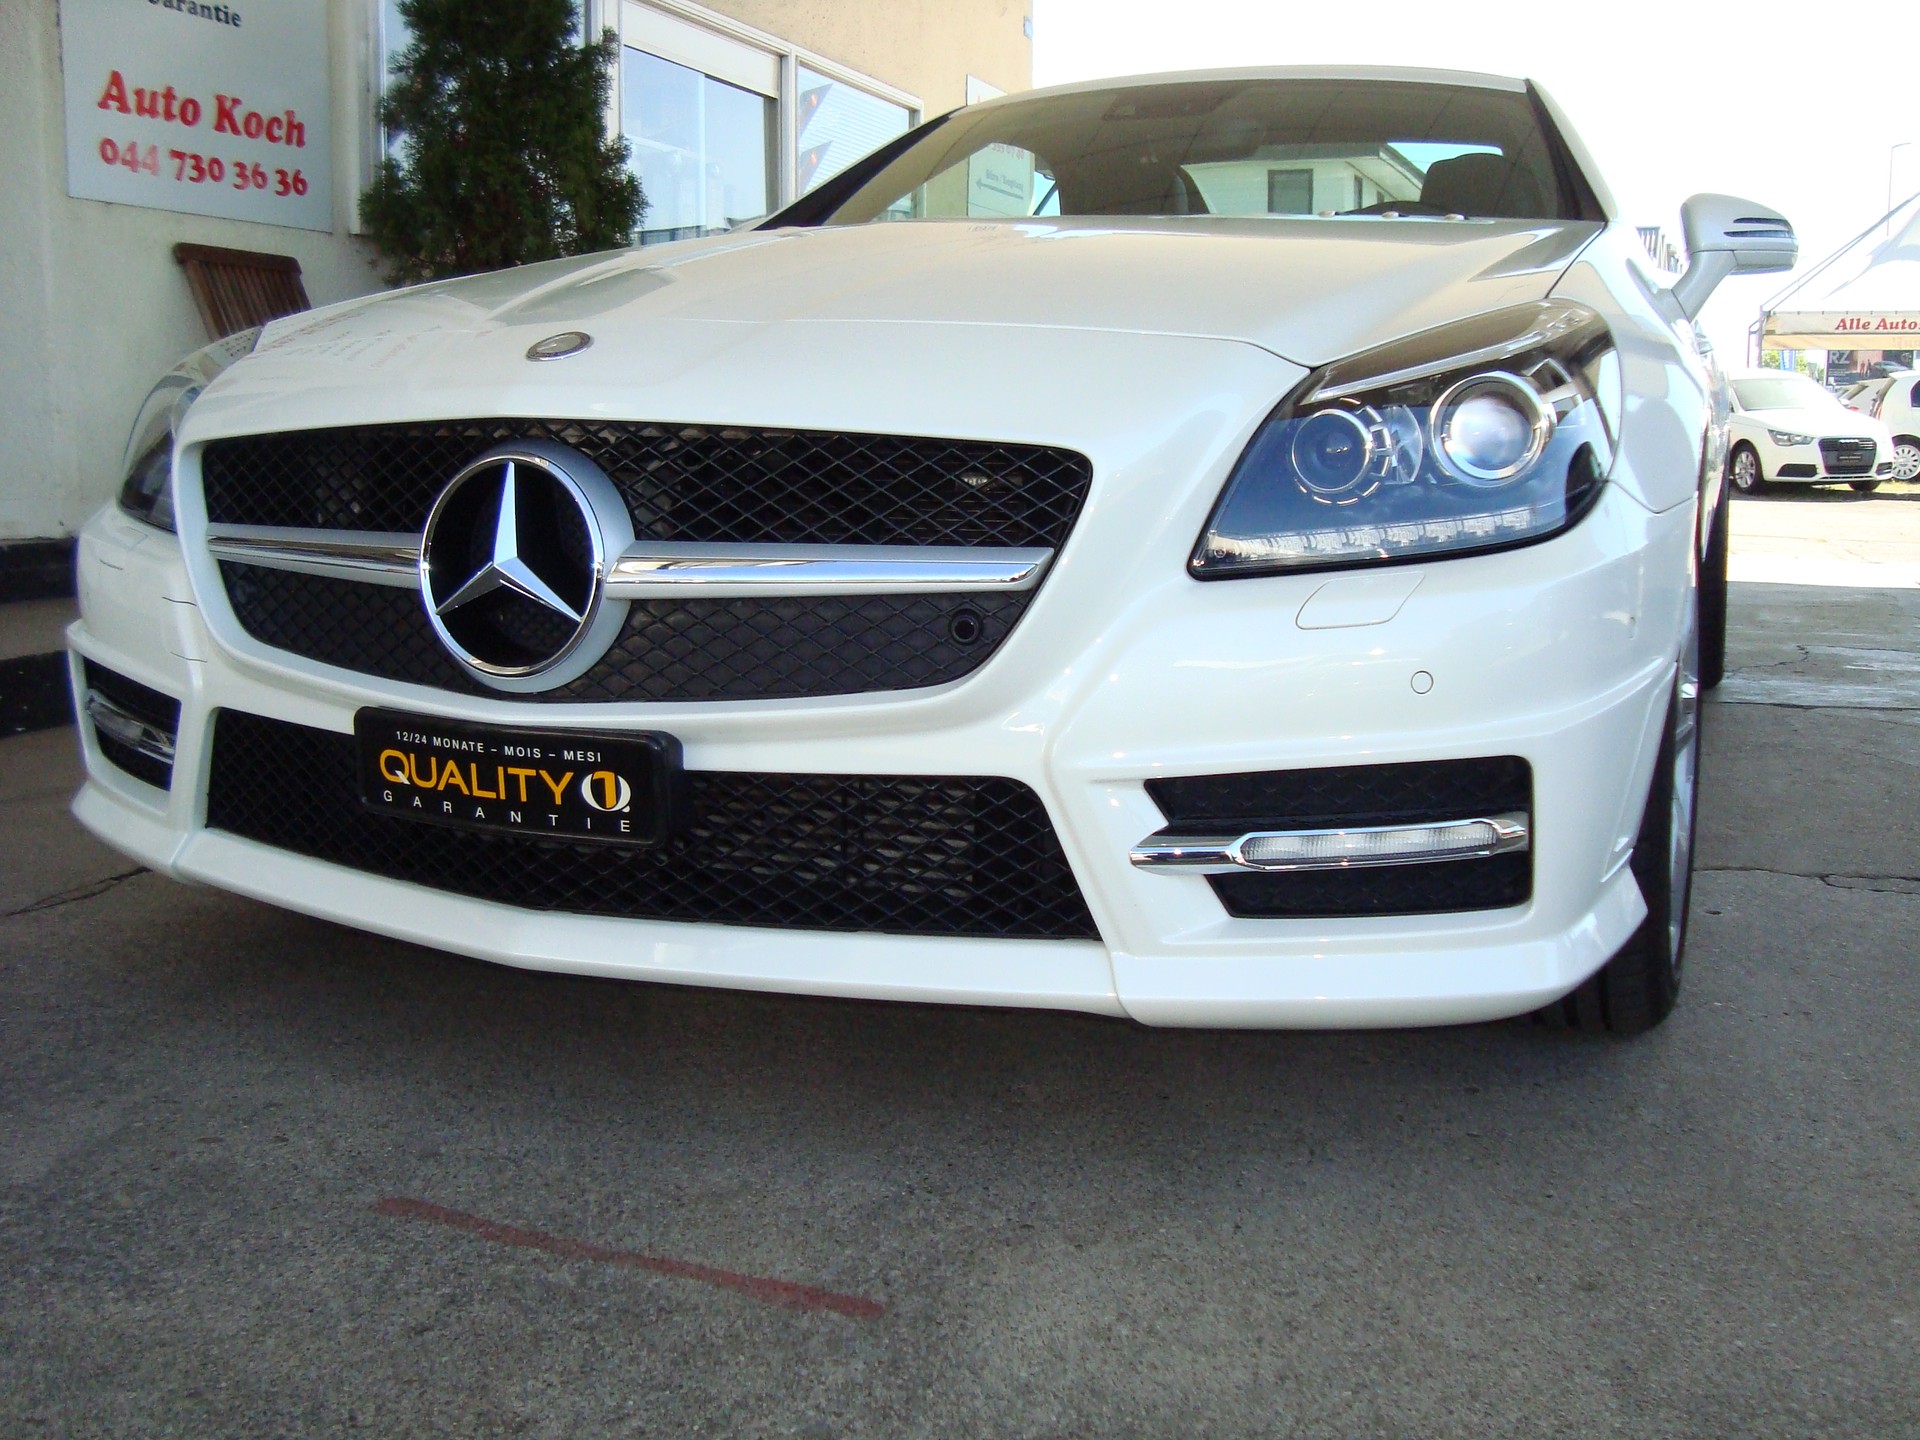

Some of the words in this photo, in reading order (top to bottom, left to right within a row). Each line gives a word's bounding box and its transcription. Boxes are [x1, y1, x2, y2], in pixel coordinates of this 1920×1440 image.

[97, 69, 201, 127] Auto
[214, 94, 306, 148] Koch
[99, 137, 160, 177] 044
[168, 149, 225, 183] 730
[233, 161, 268, 190] 36
[274, 168, 309, 197] 36
[1835, 317, 1871, 331] Alle
[1875, 316, 1920, 331] Auto
[396, 730, 427, 745] 12/24
[433, 736, 485, 753] MONATE
[504, 745, 541, 759] MOIS
[563, 750, 601, 763] MESI
[379, 748, 574, 806] QUALITY
[383, 790, 631, 833] GARANTIE
